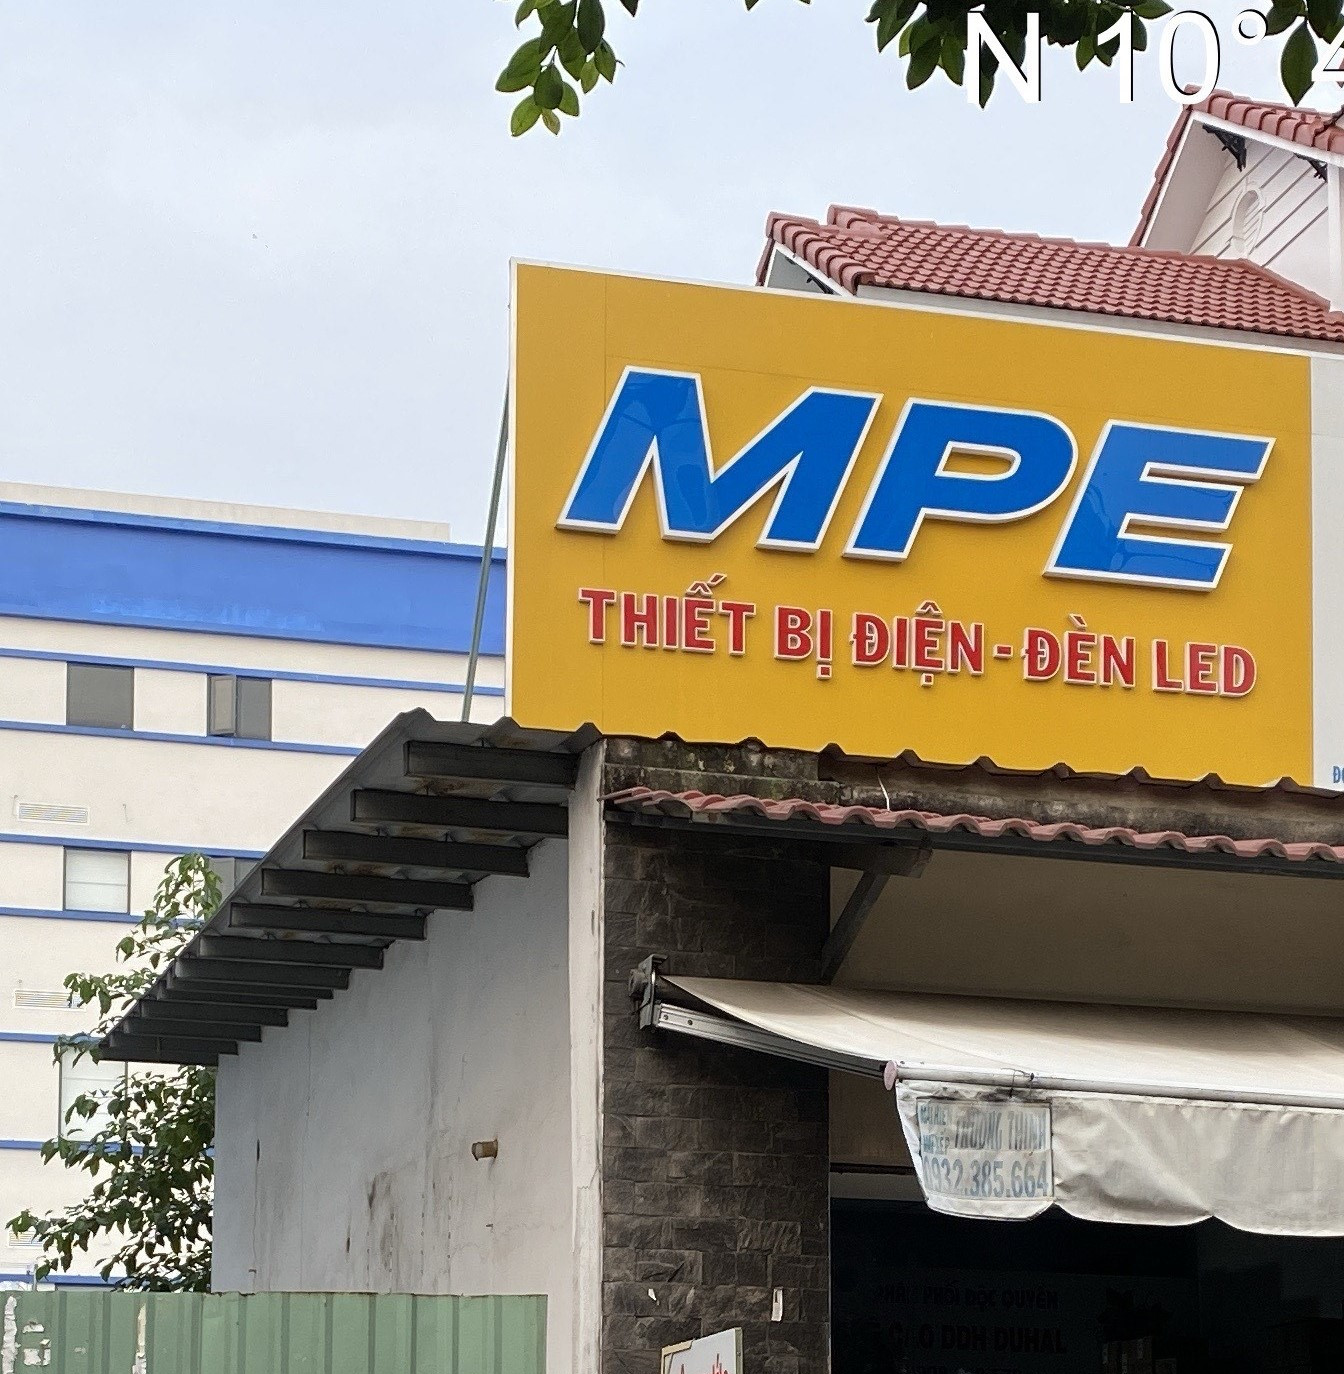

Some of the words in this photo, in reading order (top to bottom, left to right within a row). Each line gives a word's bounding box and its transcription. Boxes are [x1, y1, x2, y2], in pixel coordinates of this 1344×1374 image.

[556, 365, 1277, 592] MPE
[579, 573, 755, 657] THIẾT
[774, 604, 832, 681] BỊ
[850, 601, 985, 688] ĐIỆN
[1022, 613, 1136, 690] ĐÈN
[1151, 639, 1258, 697] LED
